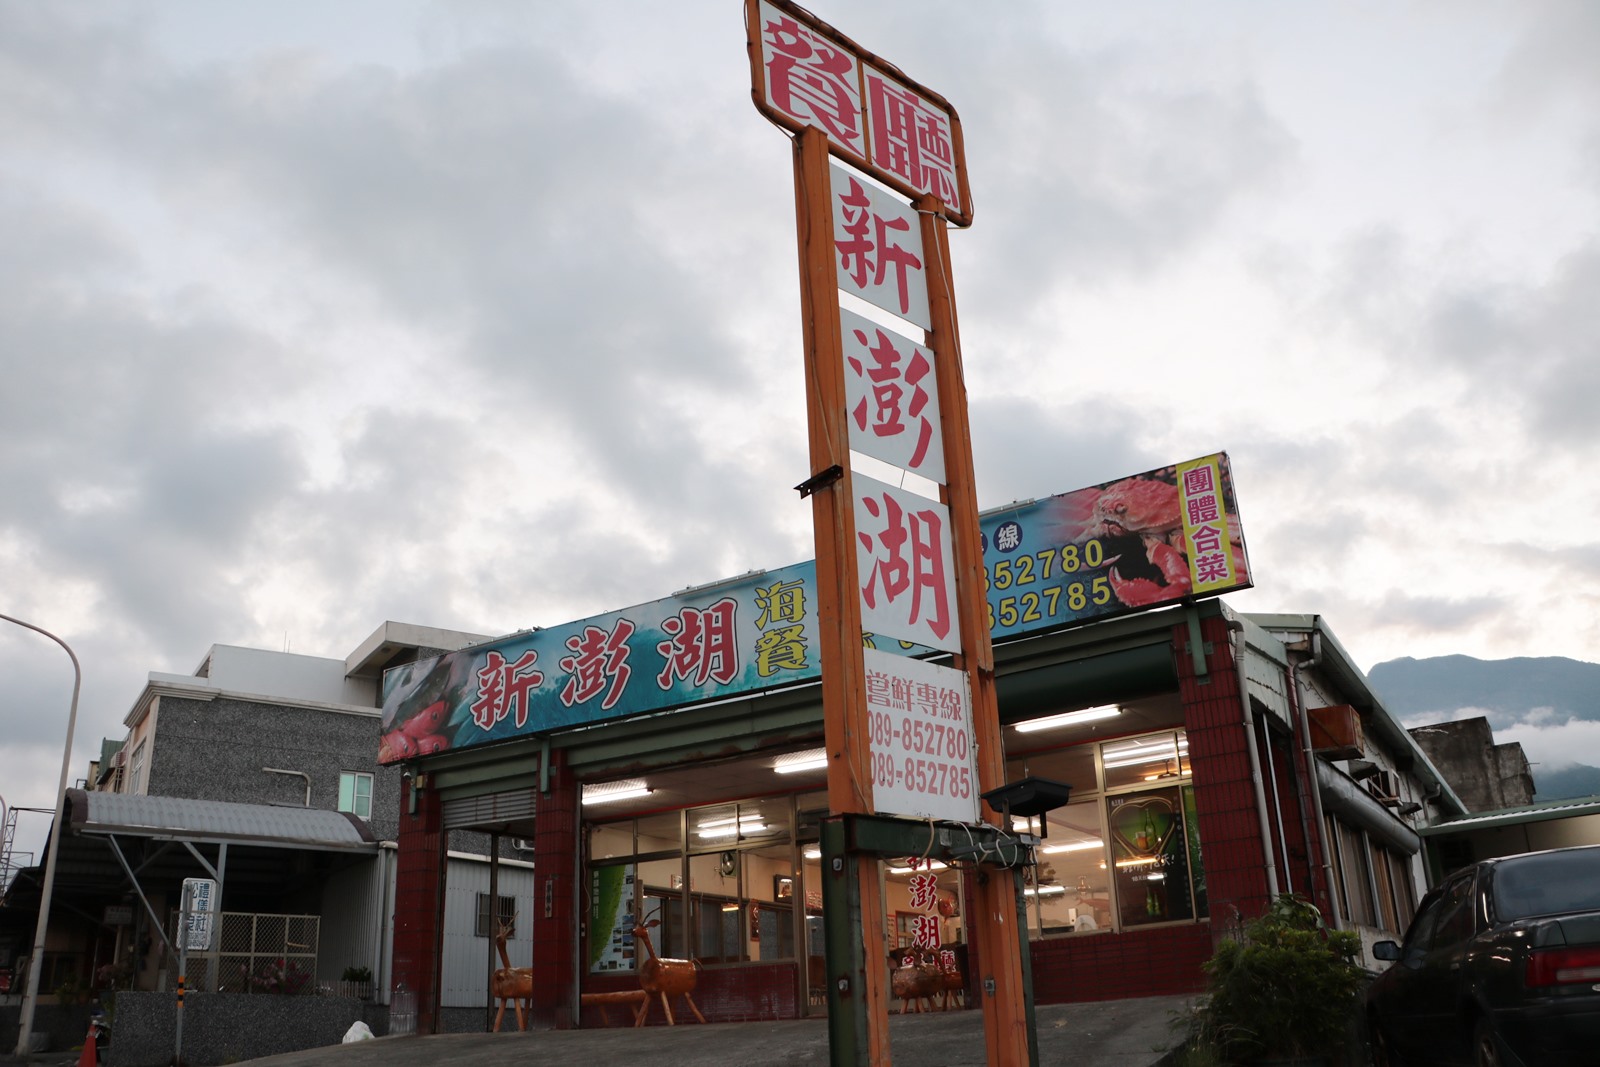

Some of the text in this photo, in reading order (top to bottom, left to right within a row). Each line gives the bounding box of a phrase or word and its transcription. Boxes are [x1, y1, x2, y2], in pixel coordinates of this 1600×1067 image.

[763, 15, 958, 209] 餐廳
[833, 175, 951, 641] 新澎湖
[1182, 464, 1230, 584] 團體合菜
[469, 596, 738, 732] 新澎湖
[866, 669, 963, 722] 嘗鮮專線
